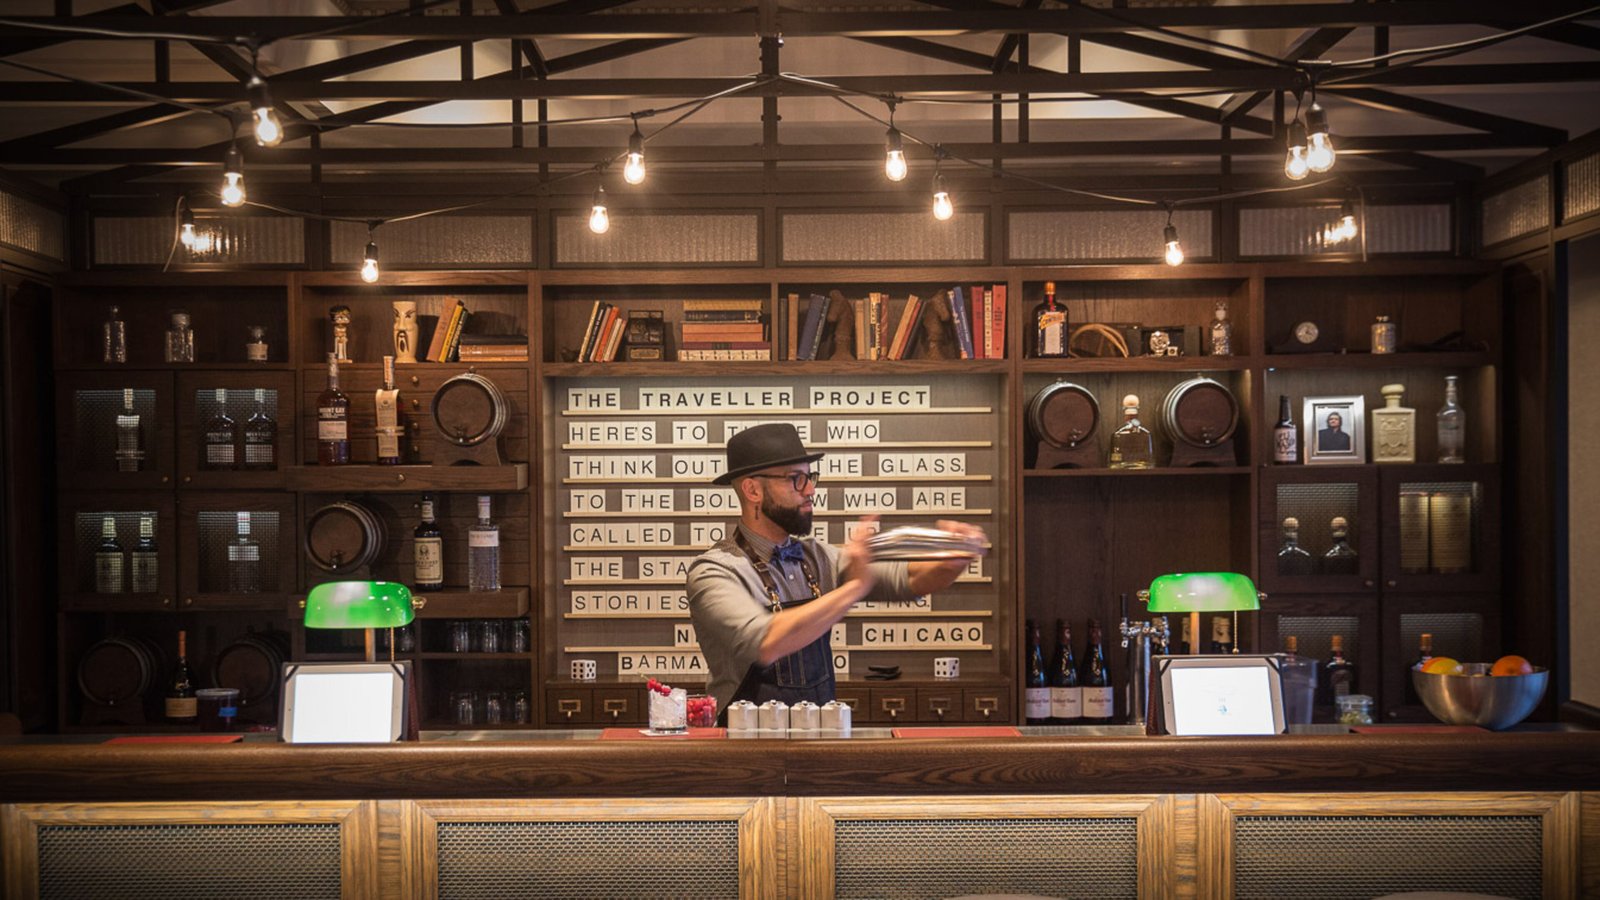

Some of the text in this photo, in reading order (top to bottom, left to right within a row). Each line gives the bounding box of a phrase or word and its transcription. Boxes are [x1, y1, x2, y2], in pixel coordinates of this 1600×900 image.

[571, 390, 928, 407] THE TRAVELLER PROJECT
[571, 424, 878, 441] HERE'S TO WHO
[572, 460, 654, 475] THINK
[881, 457, 964, 473] GLASS.
[573, 494, 604, 509] TO
[625, 494, 671, 509] THE
[693, 494, 739, 508] BOL
[845, 492, 895, 507] WHO
[915, 492, 963, 507] ARE
[572, 528, 672, 543] CALLED
[693, 527, 724, 542] TO
[574, 561, 688, 577] THE STA
[574, 595, 690, 610] STORIES
[865, 627, 981, 642] CHICAGO
[621, 654, 702, 670] BARMA
